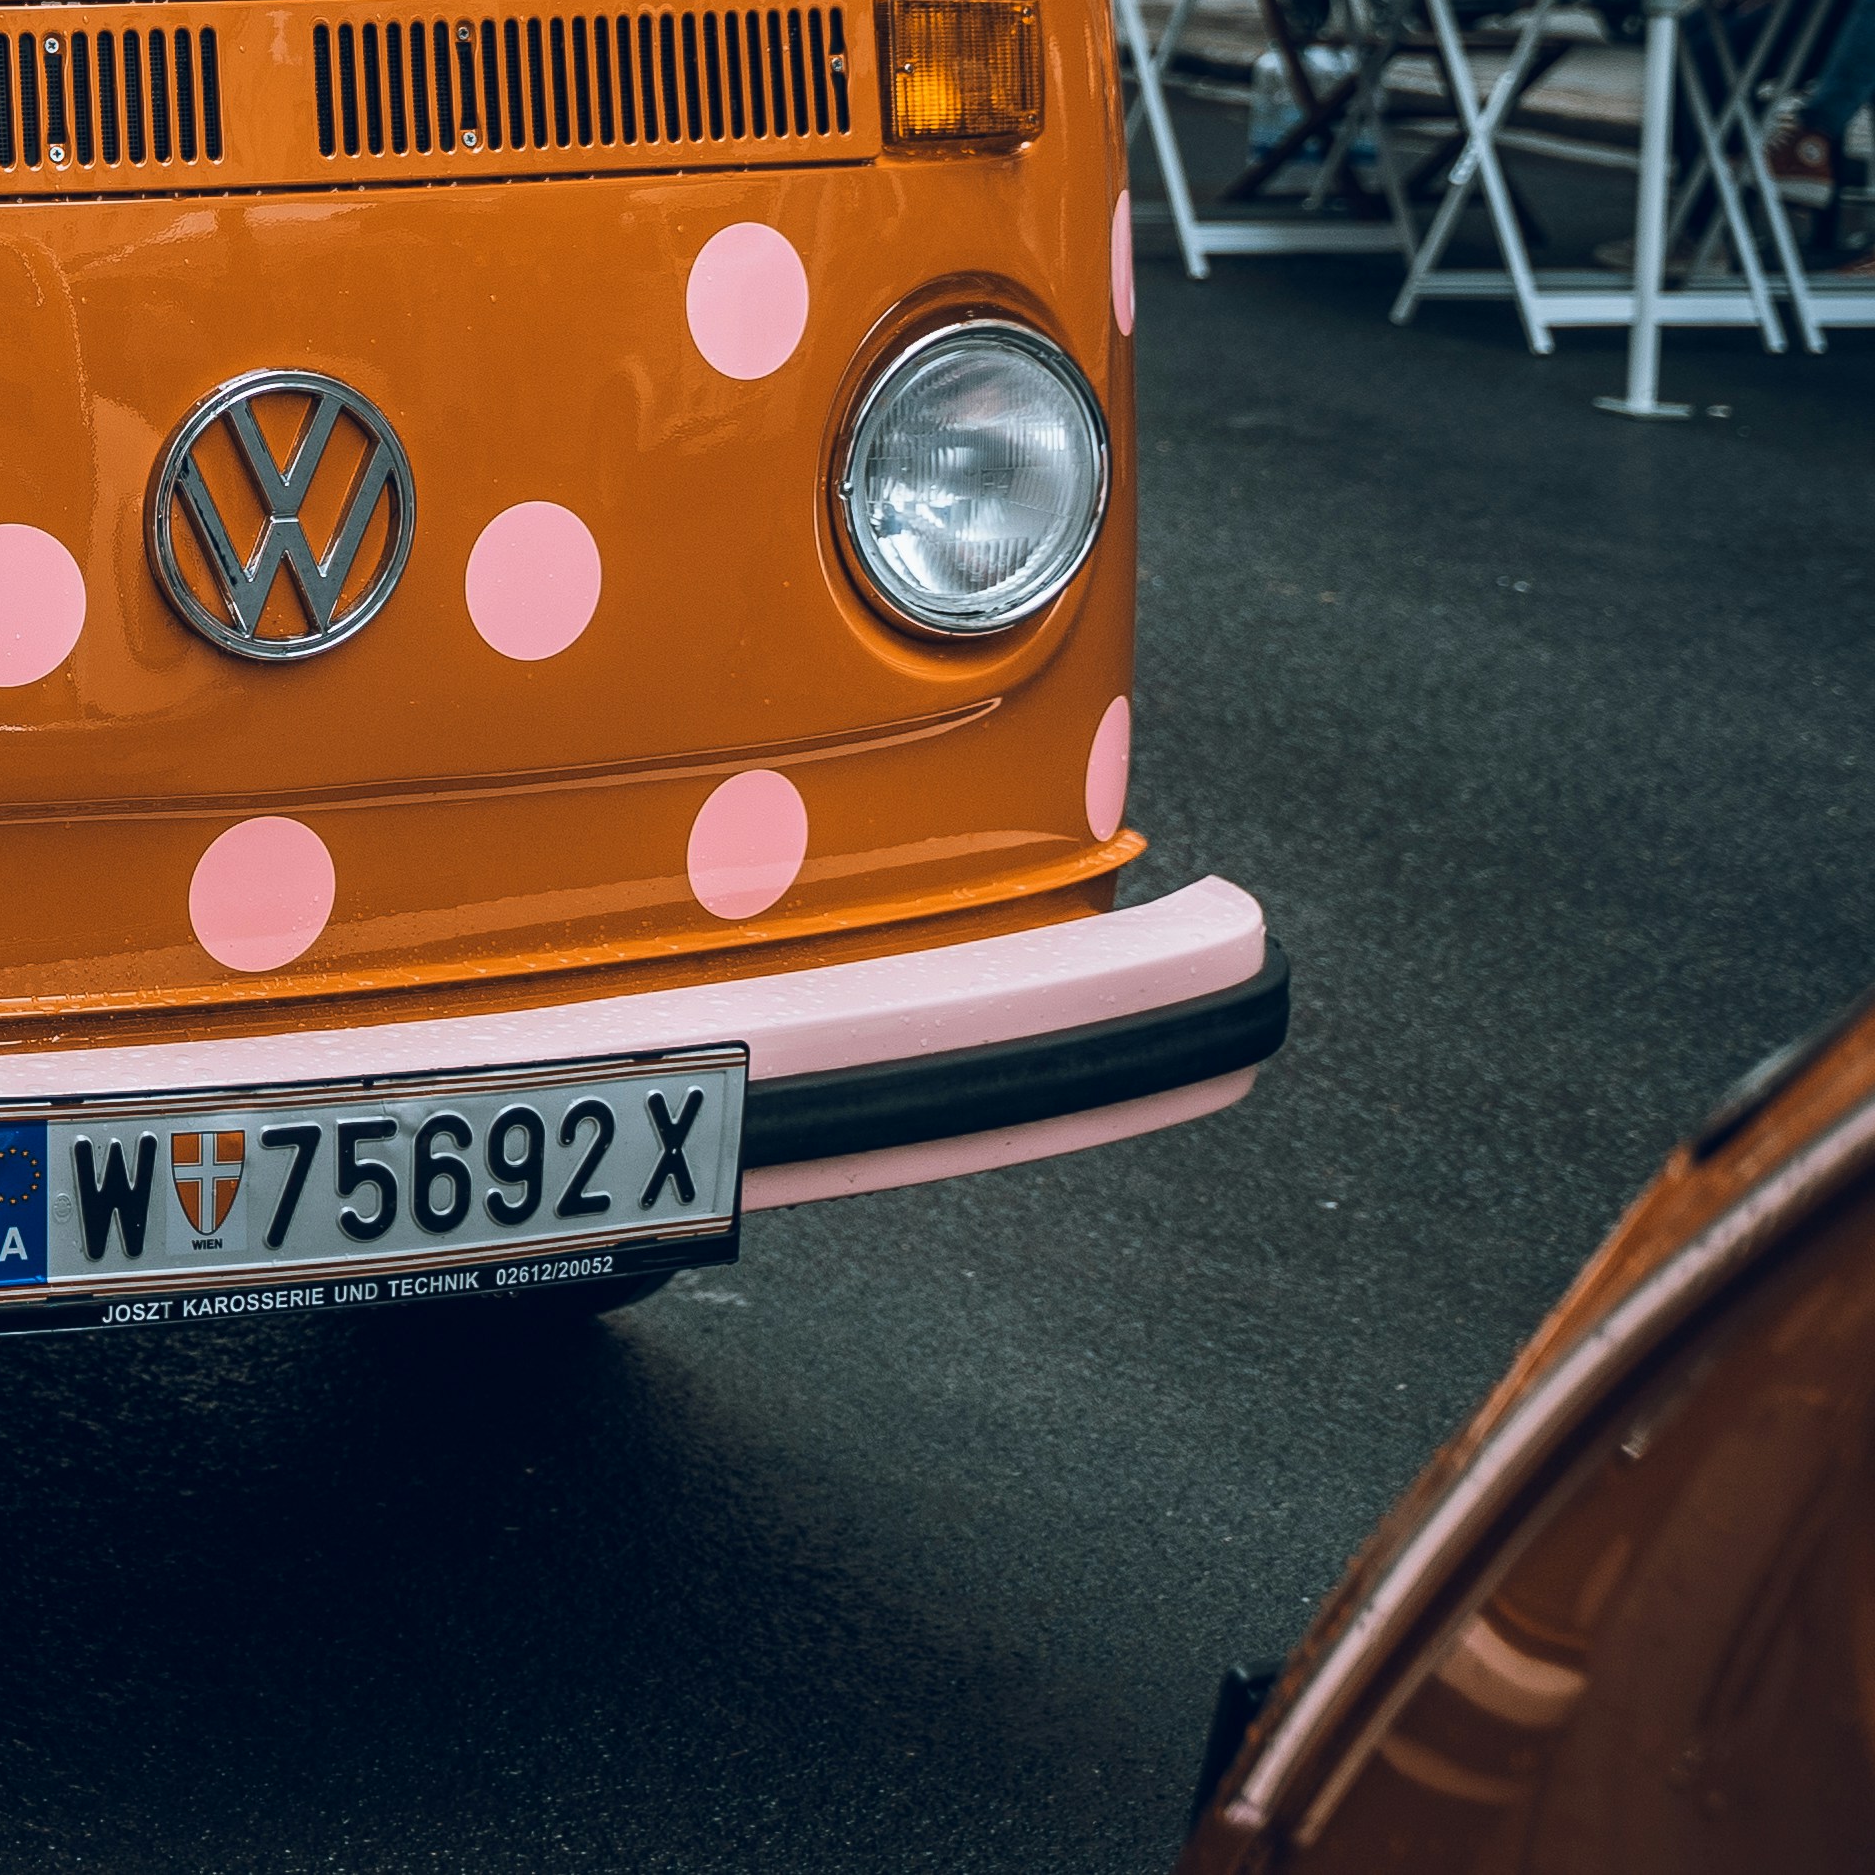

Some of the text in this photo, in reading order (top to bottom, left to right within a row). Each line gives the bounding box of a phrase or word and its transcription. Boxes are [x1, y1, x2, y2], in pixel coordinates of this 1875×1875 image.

[163, 382, 403, 648] VW
[72, 1085, 705, 1263] W 75692 X
[101, 1255, 614, 1325] JOSZT KAROSSERIE UND TECHNIK 02612/20052
[191, 1238, 223, 1251] WIEN
